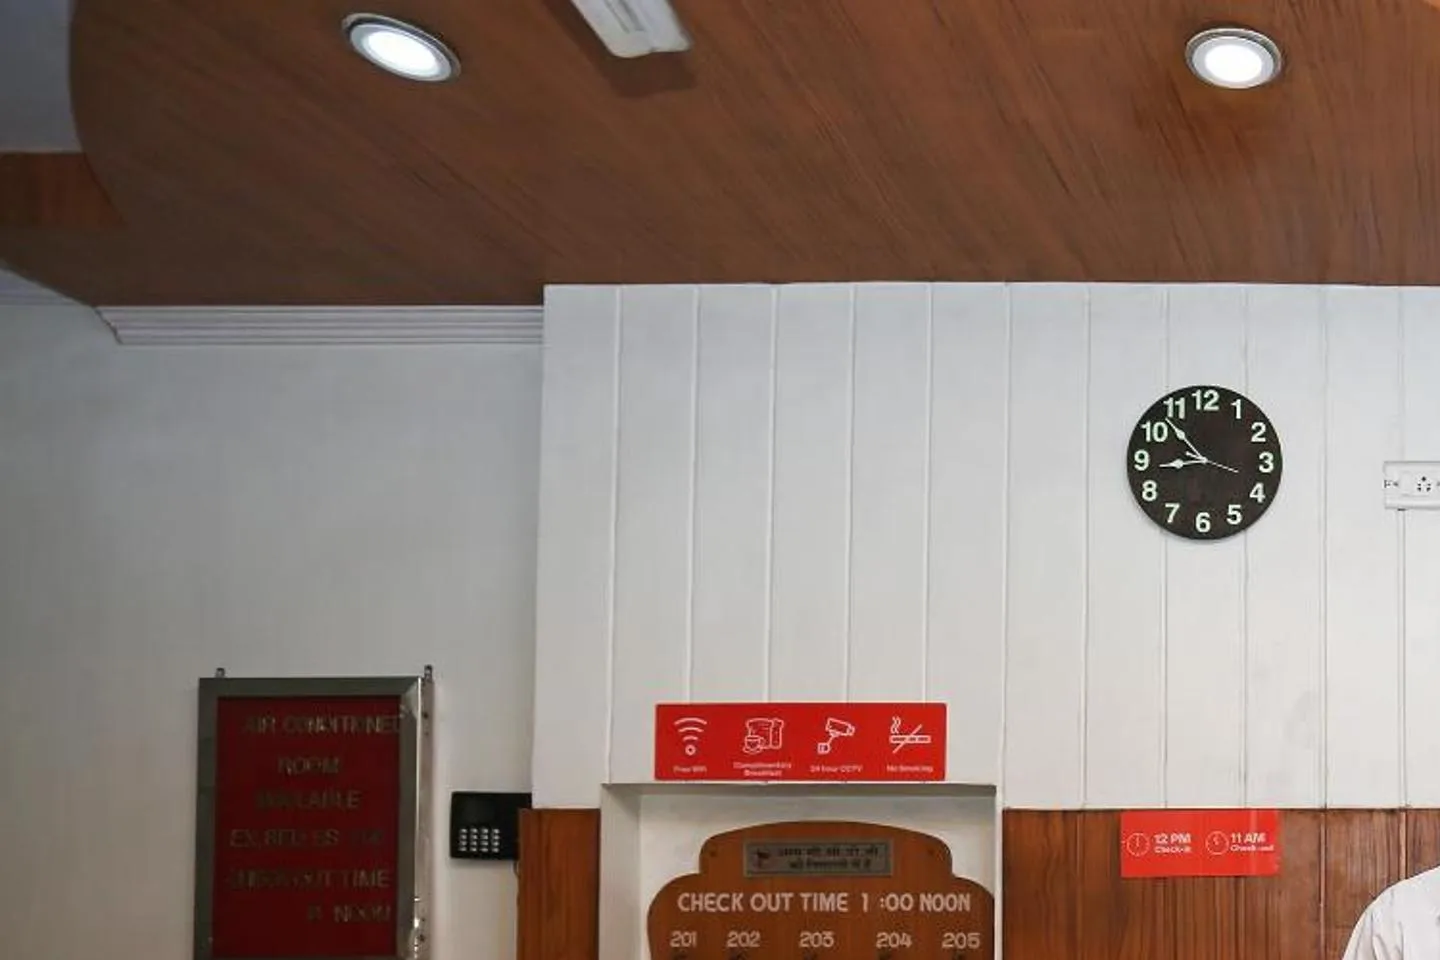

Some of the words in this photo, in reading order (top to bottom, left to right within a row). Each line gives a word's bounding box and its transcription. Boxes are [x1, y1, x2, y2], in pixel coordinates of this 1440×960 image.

[1163, 397, 1186, 419] 11
[1191, 389, 1220, 411] 12
[1231, 399, 1242, 419] 1
[1141, 422, 1169, 442] 10
[1251, 422, 1266, 443] 2
[1133, 449, 1150, 471] 9
[1258, 451, 1274, 473] 3
[1141, 480, 1158, 501] 8
[1249, 483, 1266, 503] 4
[1165, 503, 1180, 523] 7
[1195, 512, 1211, 533] 6
[1226, 504, 1242, 525] 5
[277, 756, 341, 775] ROOM
[1154, 832, 1169, 844] 12
[1170, 832, 1192, 844] PM
[1230, 832, 1241, 843] 11
[1243, 832, 1267, 843] AM
[339, 868, 392, 889] TIME
[677, 892, 744, 912] CHECK
[750, 893, 794, 912] OUT
[800, 893, 849, 912] TIME
[919, 893, 972, 912] NOON
[670, 930, 697, 948] 201
[726, 930, 761, 949] 202
[799, 930, 834, 949] 203
[875, 931, 912, 949] 204
[941, 931, 981, 949] 205
